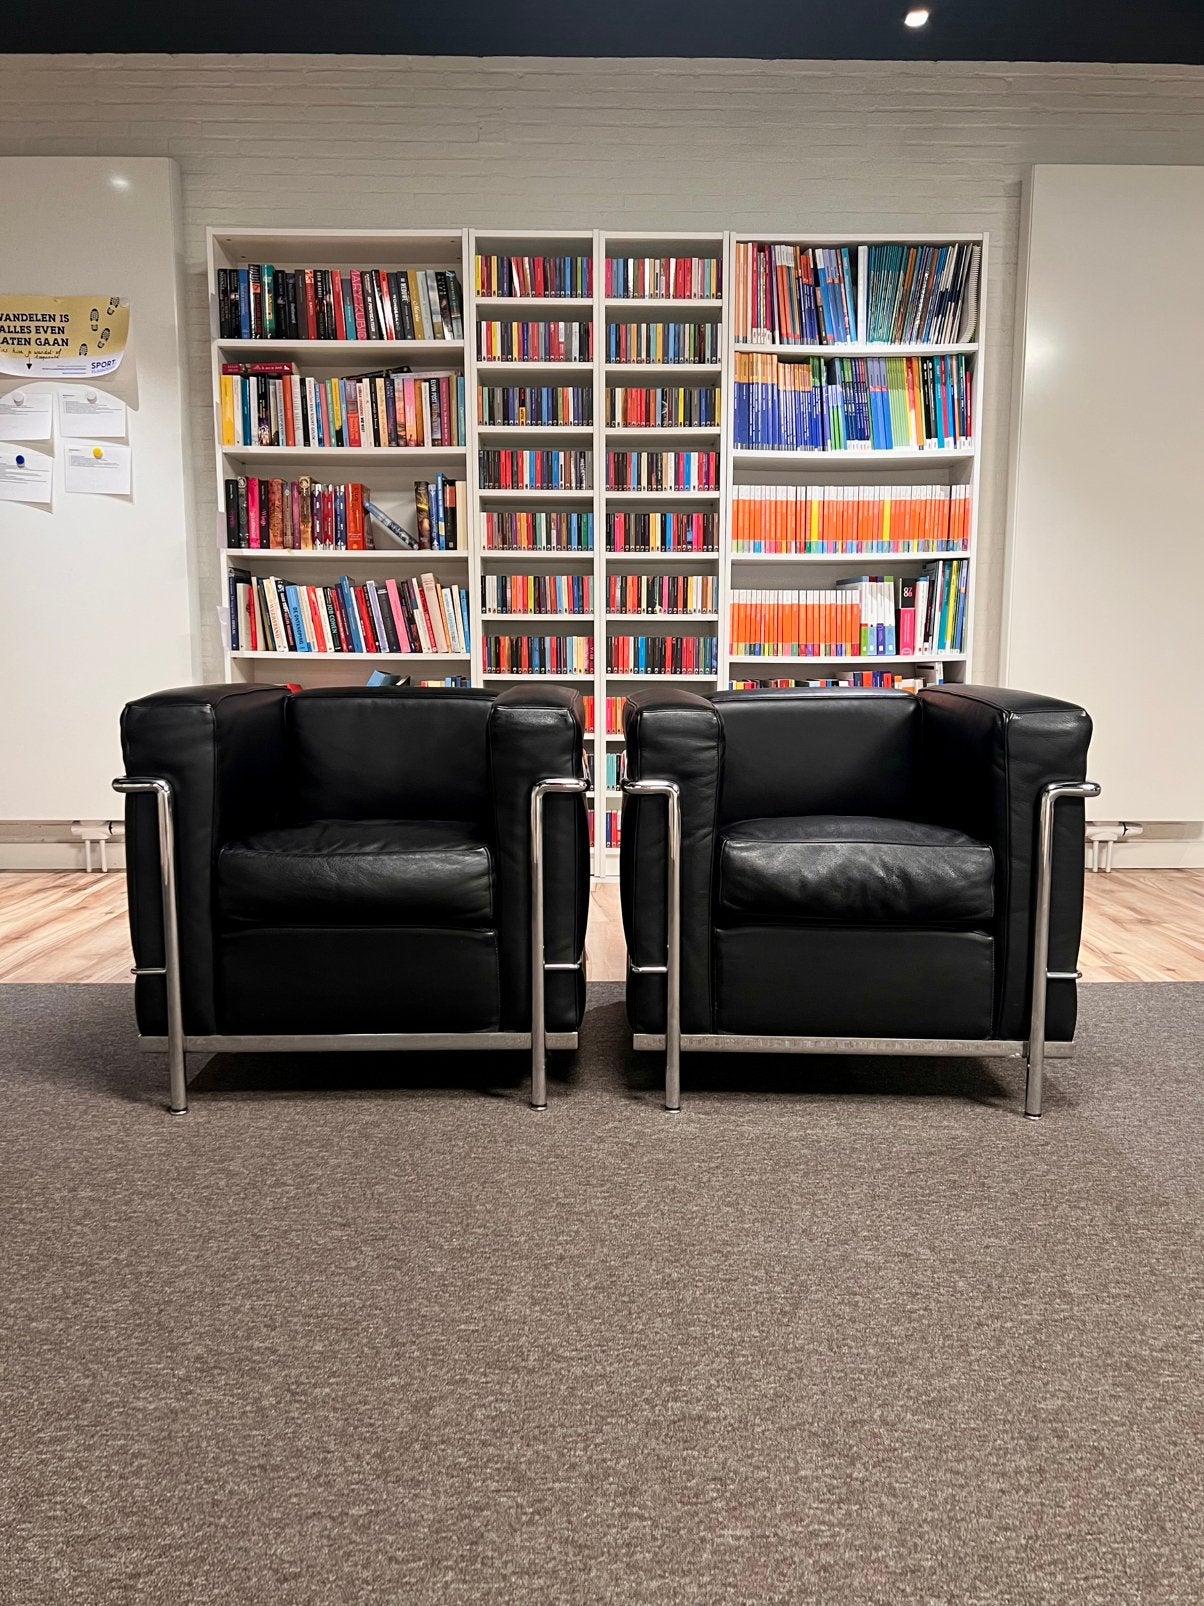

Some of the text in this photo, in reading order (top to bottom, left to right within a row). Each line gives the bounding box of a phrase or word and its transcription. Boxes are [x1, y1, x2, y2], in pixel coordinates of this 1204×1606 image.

[60, 314, 70, 323] IS
[0, 325, 65, 334] ALLES EVEN
[35, 338, 69, 347] GAAN
[91, 359, 116, 370] SPORT
[293, 614, 303, 644] ONTKNOPING
[328, 615, 336, 633] COHEN
